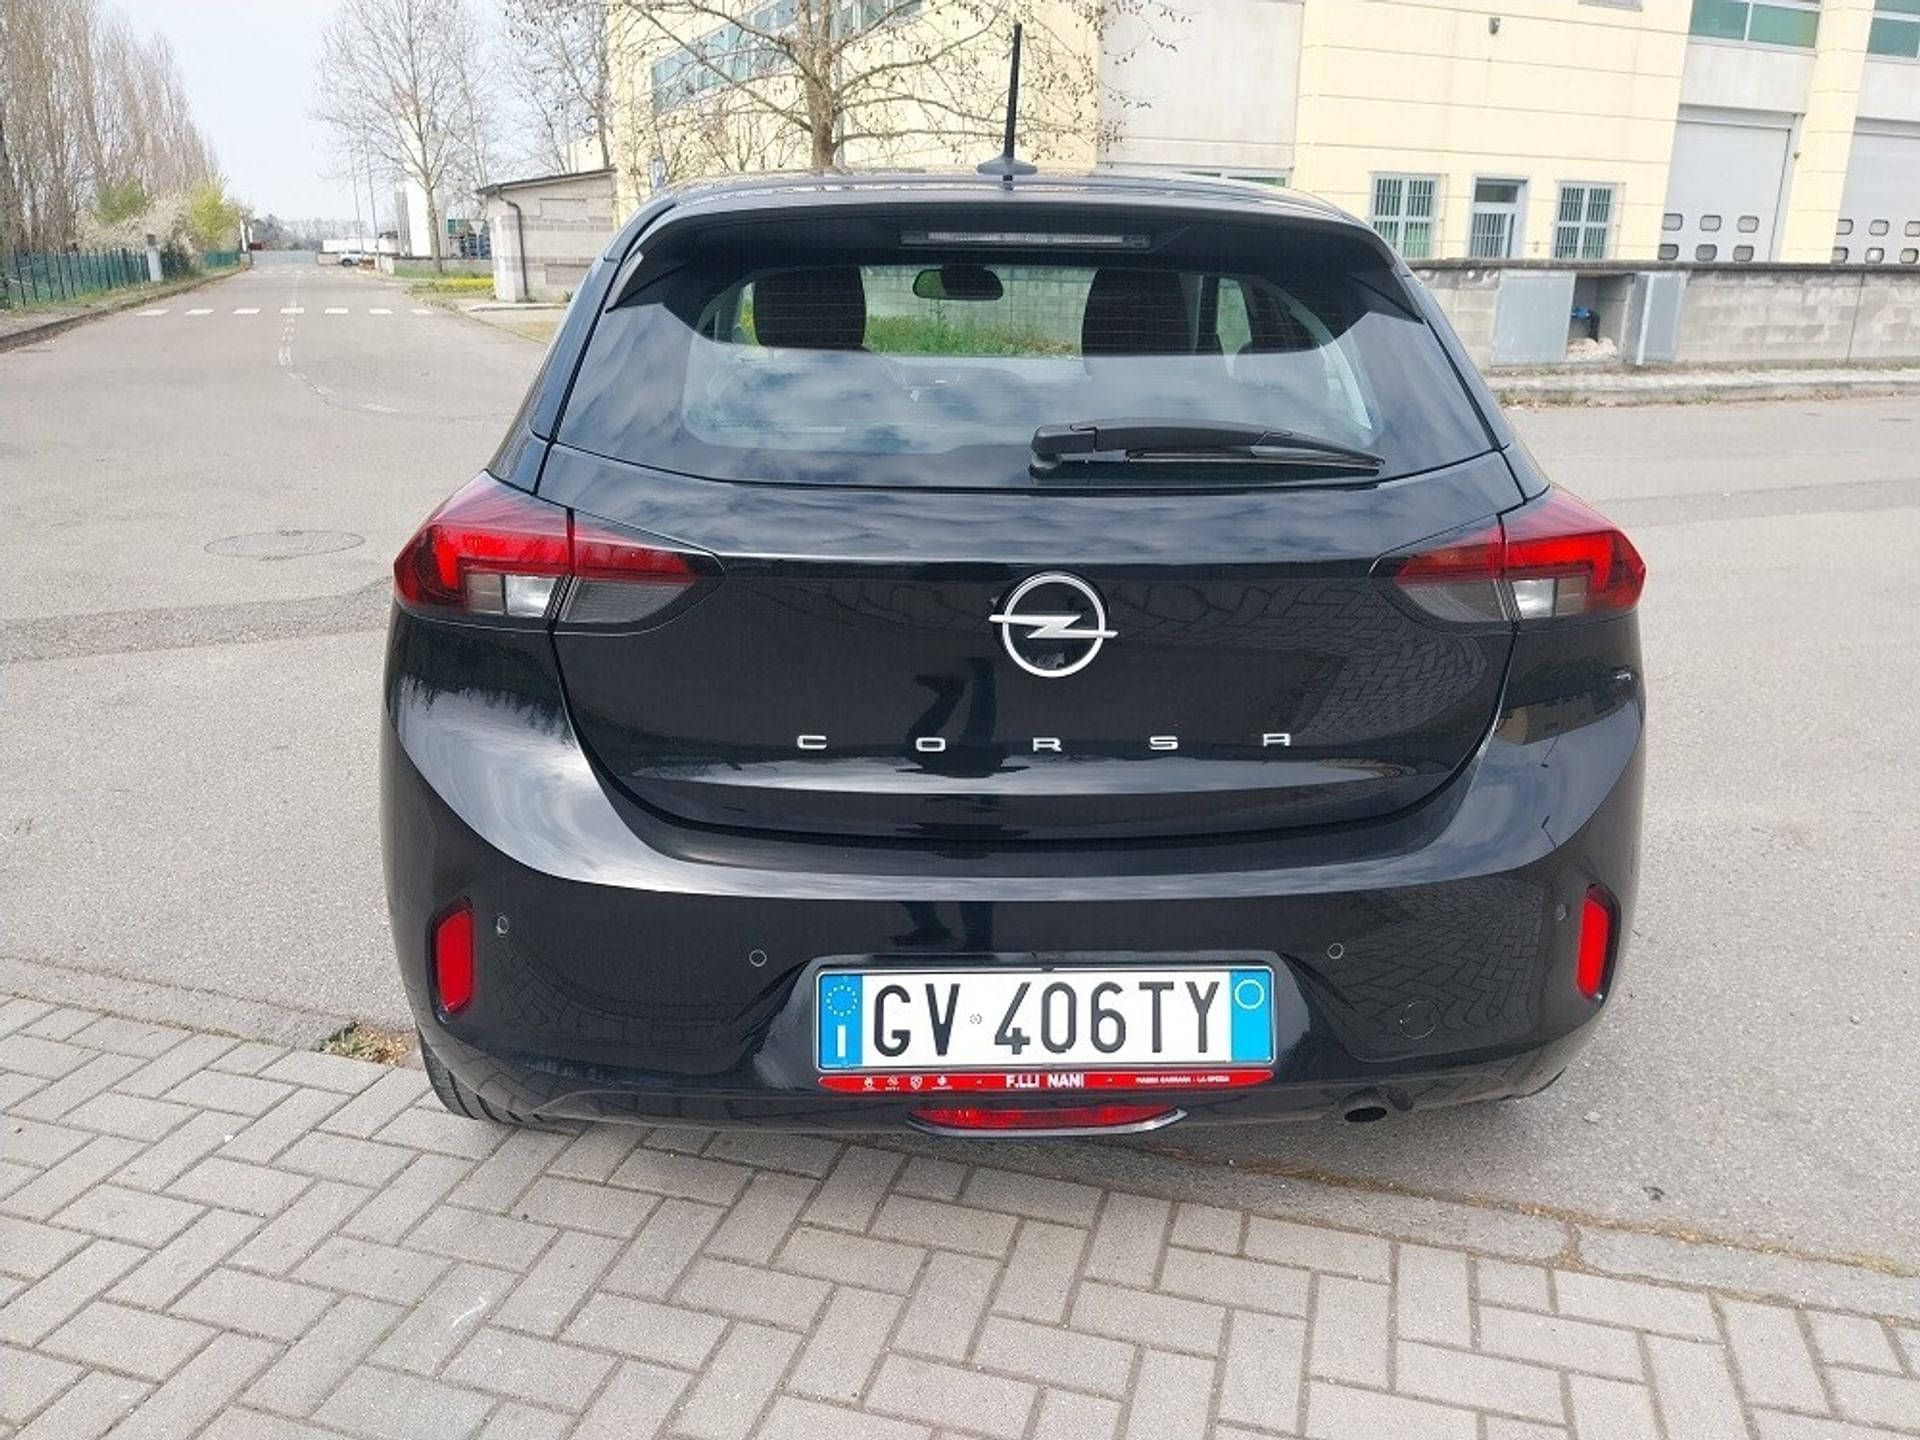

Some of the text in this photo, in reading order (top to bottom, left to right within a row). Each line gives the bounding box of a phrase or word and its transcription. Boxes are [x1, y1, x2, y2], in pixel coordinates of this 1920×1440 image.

[796, 732, 1292, 753] CORSA
[873, 981, 1220, 1058] GV 406TY
[836, 1024, 846, 1058] I
[1005, 1072, 1084, 1089] F.LLI NANI
